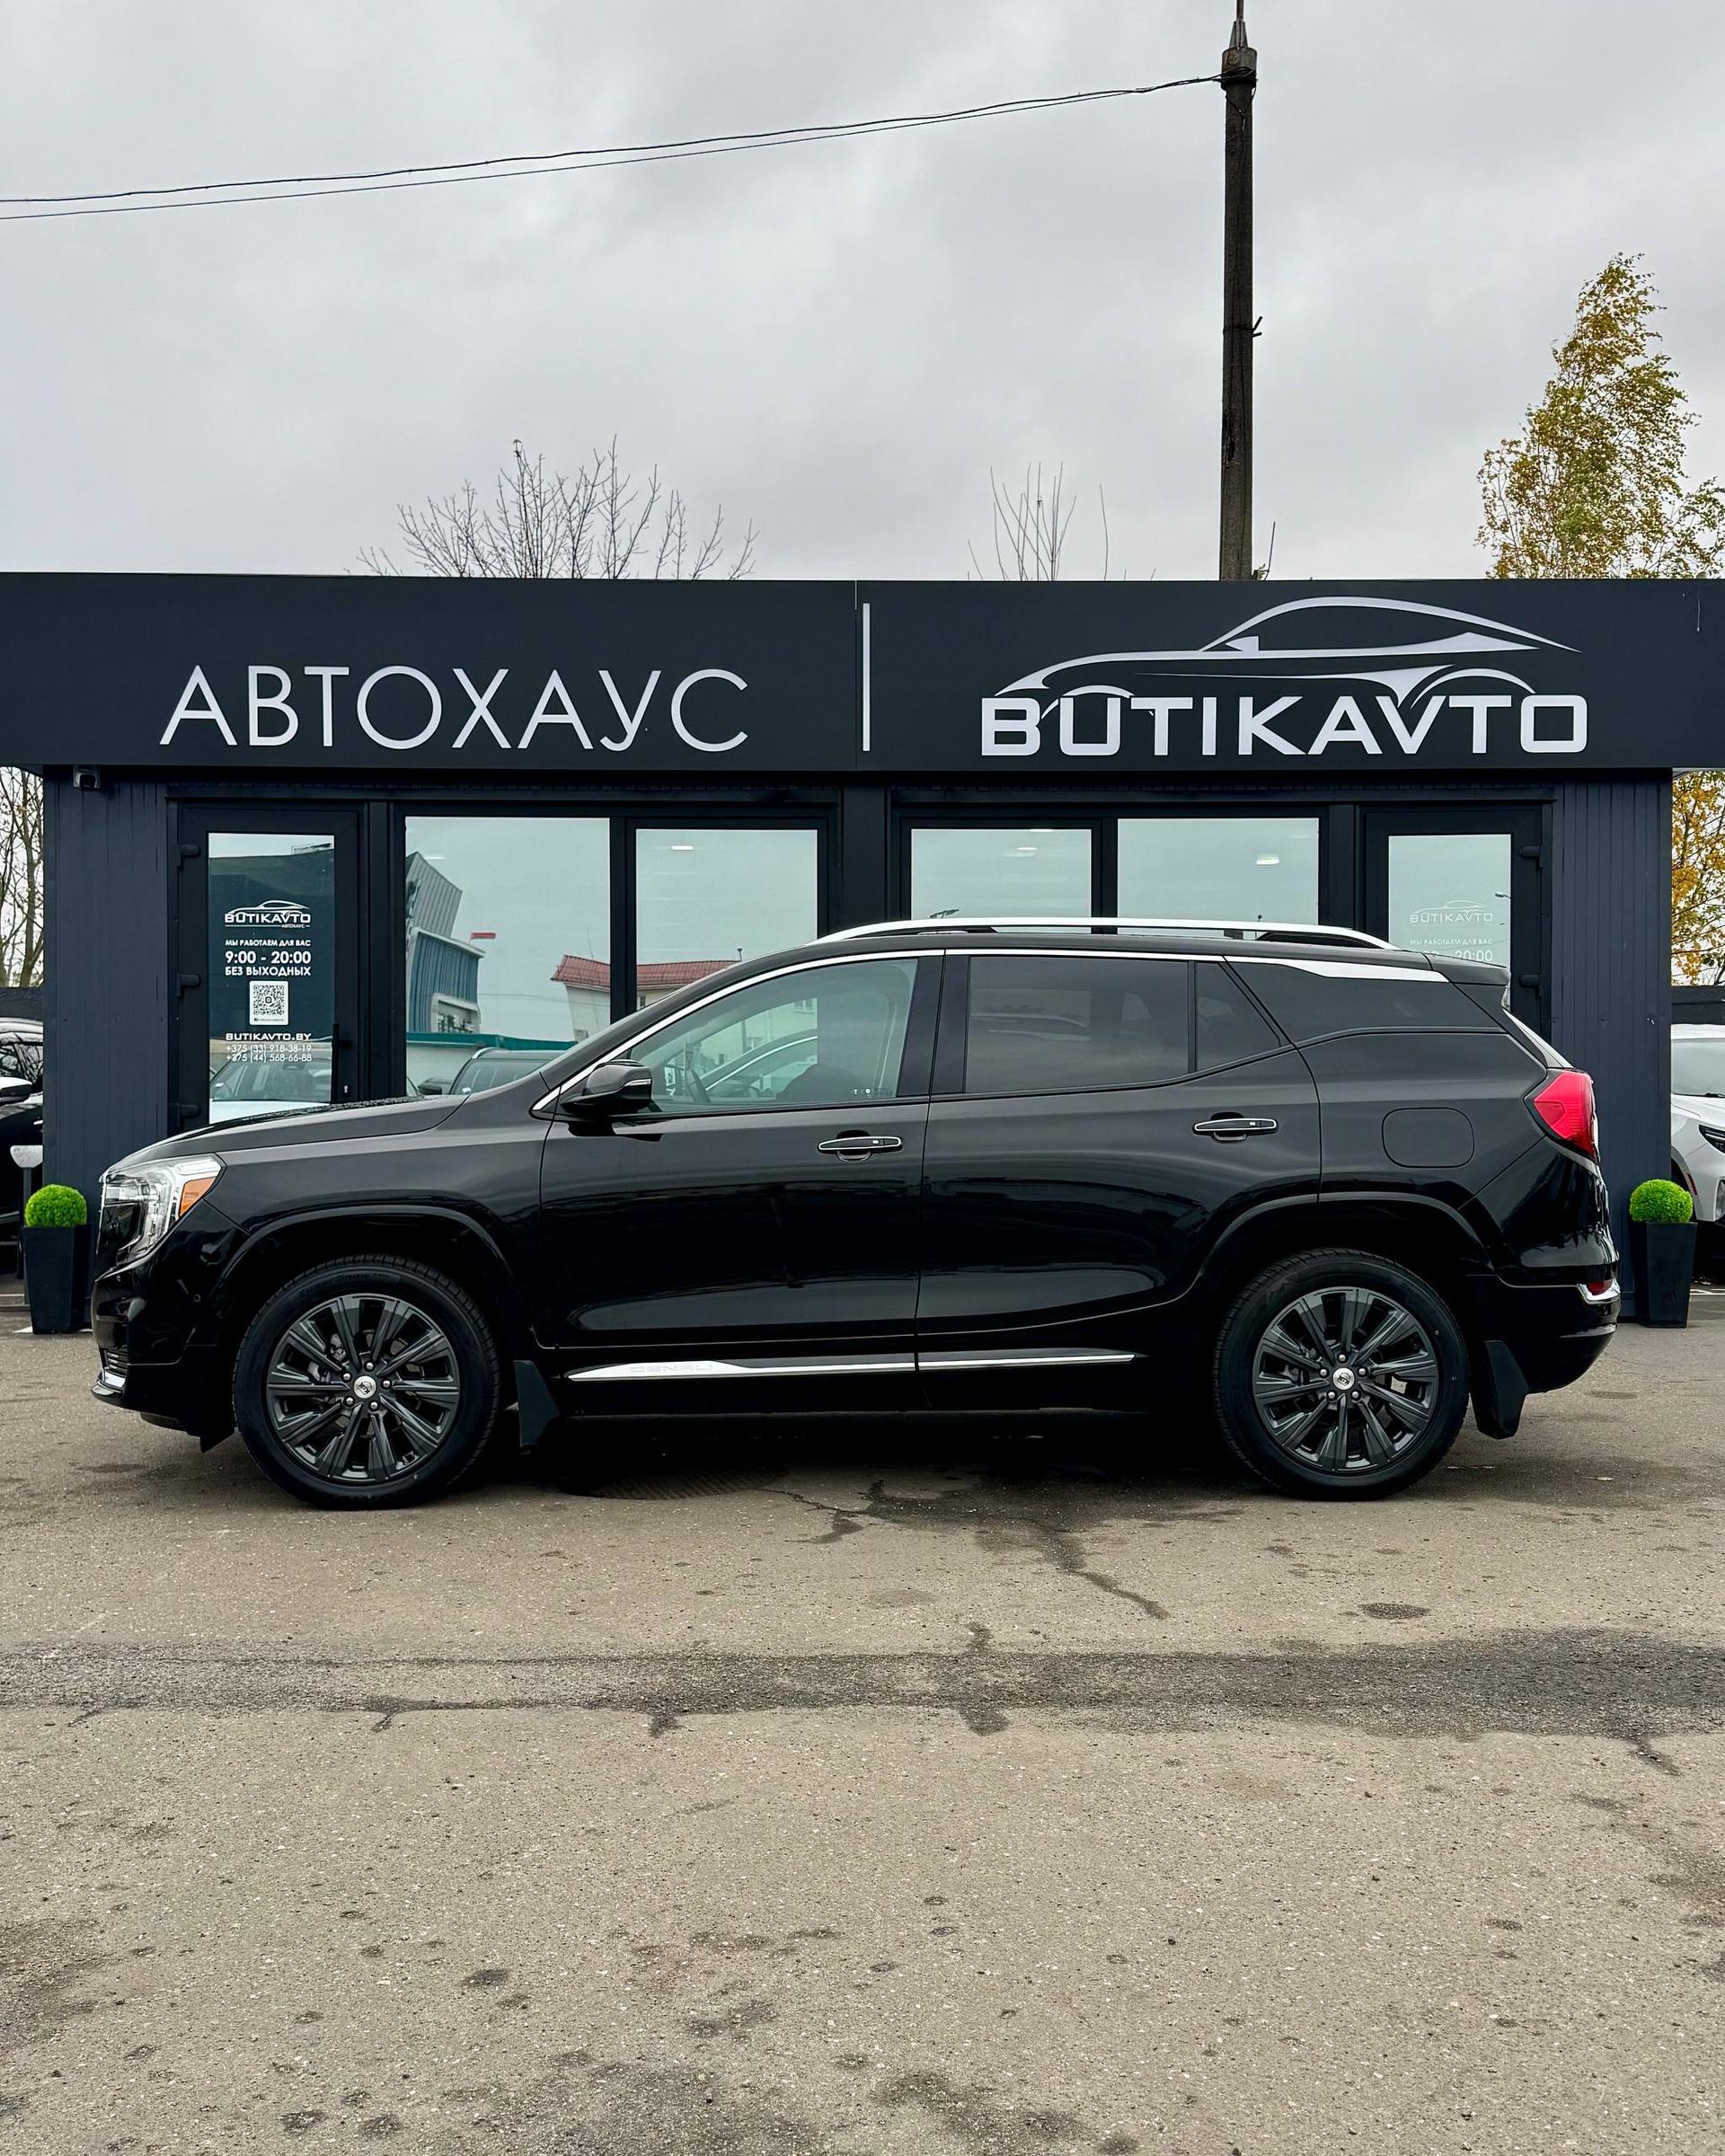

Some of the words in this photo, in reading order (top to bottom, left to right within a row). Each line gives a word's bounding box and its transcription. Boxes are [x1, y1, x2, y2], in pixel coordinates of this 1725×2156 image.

[160, 665, 749, 753] АВТОХАУС
[981, 694, 1588, 756] BUTIKAVTO
[225, 913, 311, 923] BUTIKAVTO
[1410, 912, 1493, 923] BUTIKAVTO
[225, 950, 257, 964] 9:00
[270, 950, 312, 964] 20:00
[225, 967, 243, 976] БЕЗ
[246, 967, 312, 976] ВЫХОДНЫХ
[226, 1045, 248, 1053] +375
[250, 1044, 266, 1054] (33)
[270, 1045, 312, 1053] 918-38-19
[226, 1054, 248, 1062] +375
[250, 1053, 266, 1064] (44)
[270, 1054, 313, 1062] 568-66-88
